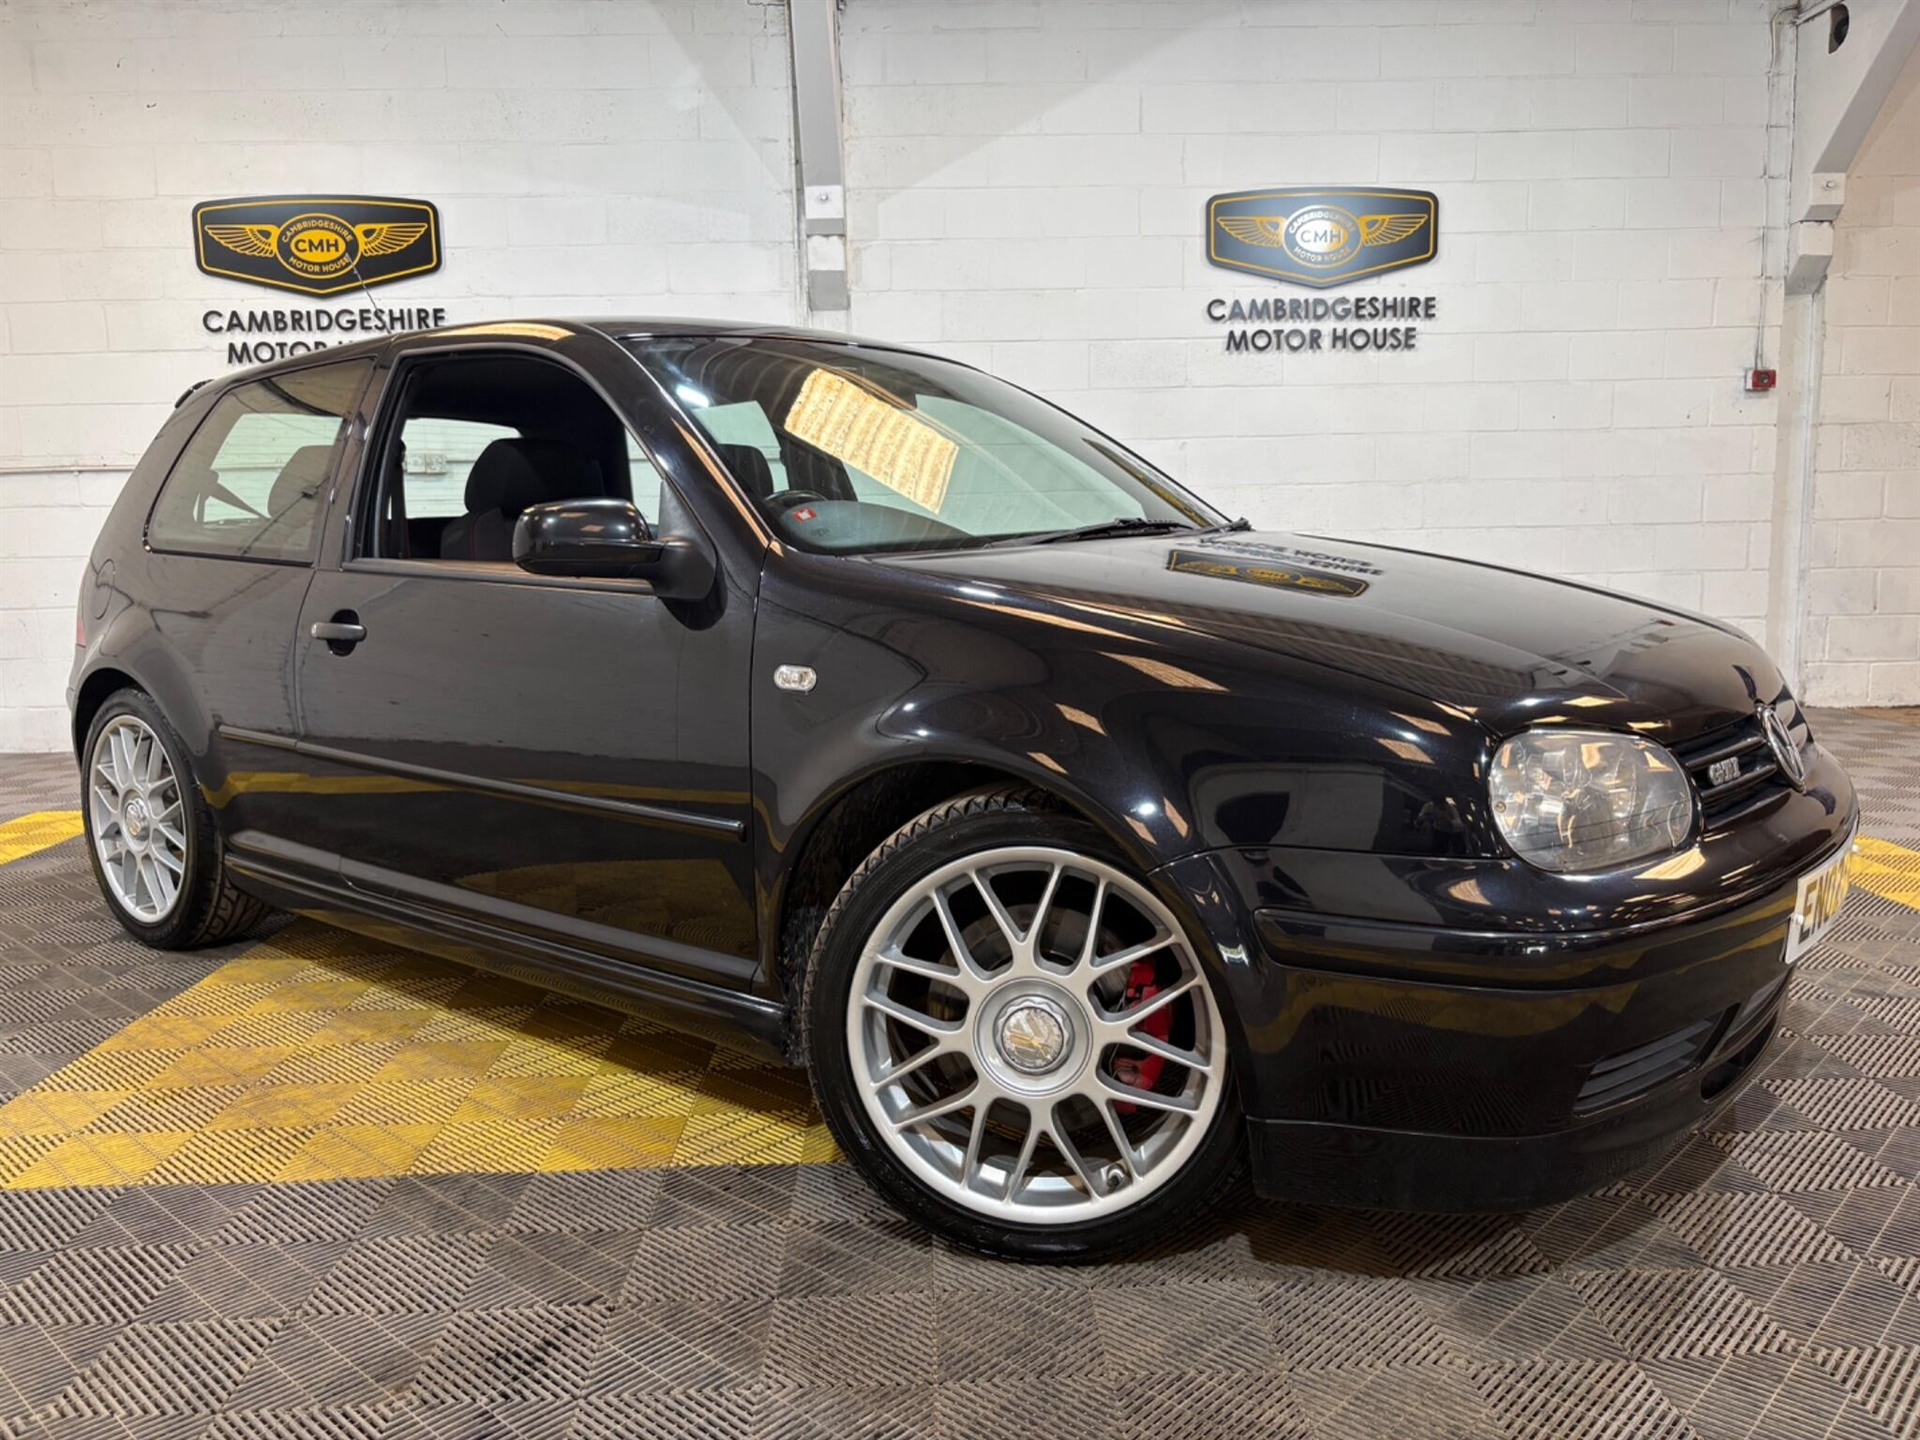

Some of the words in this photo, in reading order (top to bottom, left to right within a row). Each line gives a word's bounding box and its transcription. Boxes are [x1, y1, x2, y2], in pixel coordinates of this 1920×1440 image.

[281, 218, 353, 243] CAMBRIDGESHIRE
[1300, 229, 1343, 244] CMH
[294, 238, 340, 253] CMH
[1294, 247, 1322, 262] MOTOR
[289, 255, 320, 273] MOTOR
[322, 254, 351, 272] HOUSE
[203, 308, 446, 333] CAMBRIDGESHIRE
[1207, 296, 1437, 322] CAMBRIDGESHIRE
[1226, 329, 1323, 352] MOTOR
[1332, 327, 1417, 350] HOUSE
[1709, 756, 1740, 786] GTI
